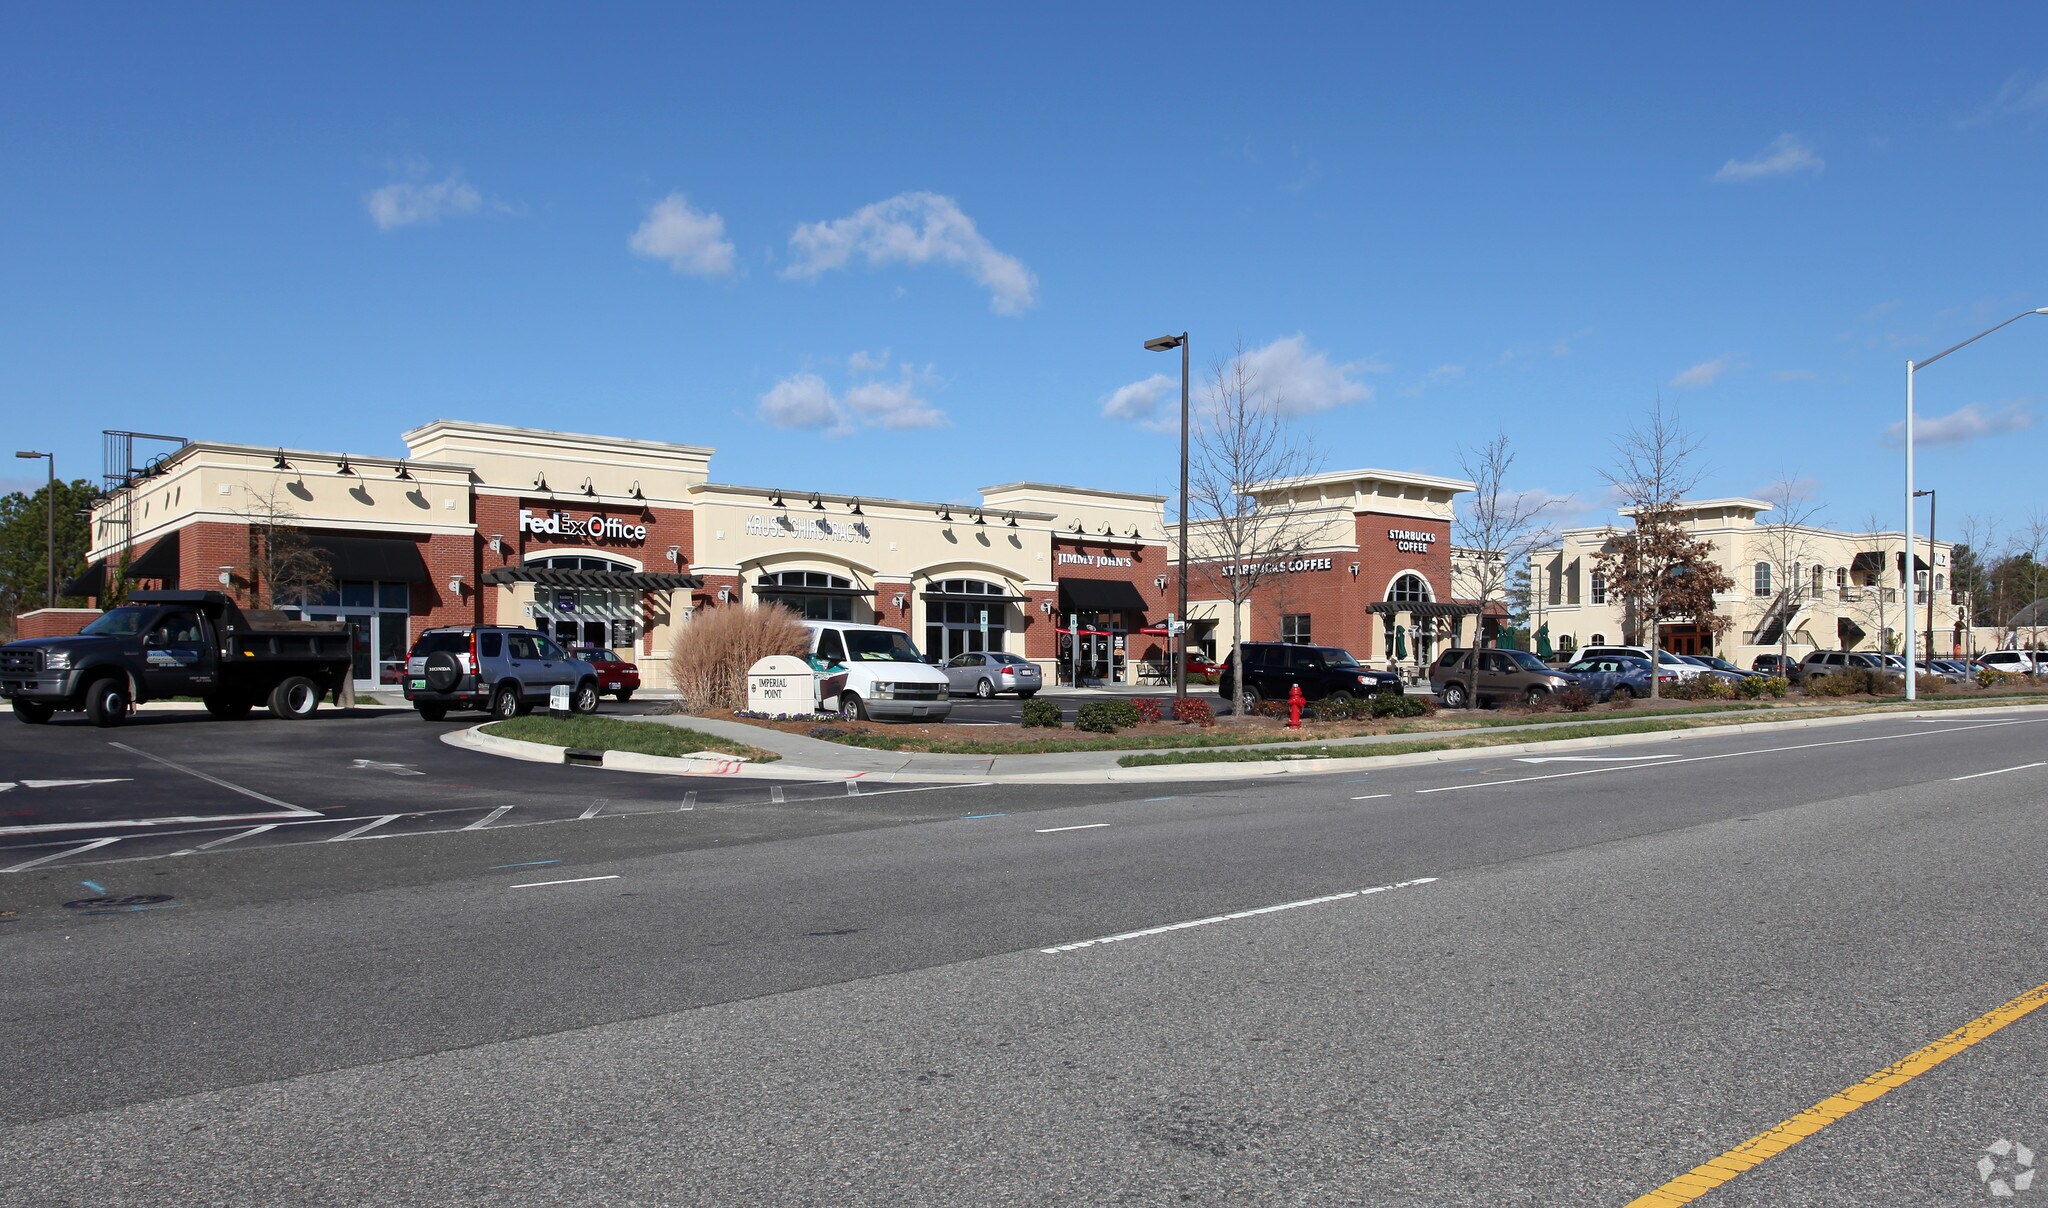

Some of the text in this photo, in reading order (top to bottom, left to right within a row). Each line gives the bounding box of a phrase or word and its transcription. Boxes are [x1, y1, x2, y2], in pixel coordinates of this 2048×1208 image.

[519, 509, 646, 540] FedEx Office
[746, 514, 786, 538] KRUSE
[1389, 529, 1436, 543] STARBUCKS
[1398, 541, 1428, 553] COFFEE
[1058, 553, 1132, 568] JIMMY JOHN'S
[1288, 557, 1332, 572] COFFEE
[758, 678, 788, 688] IMPERIAL
[764, 689, 782, 699] POINT
